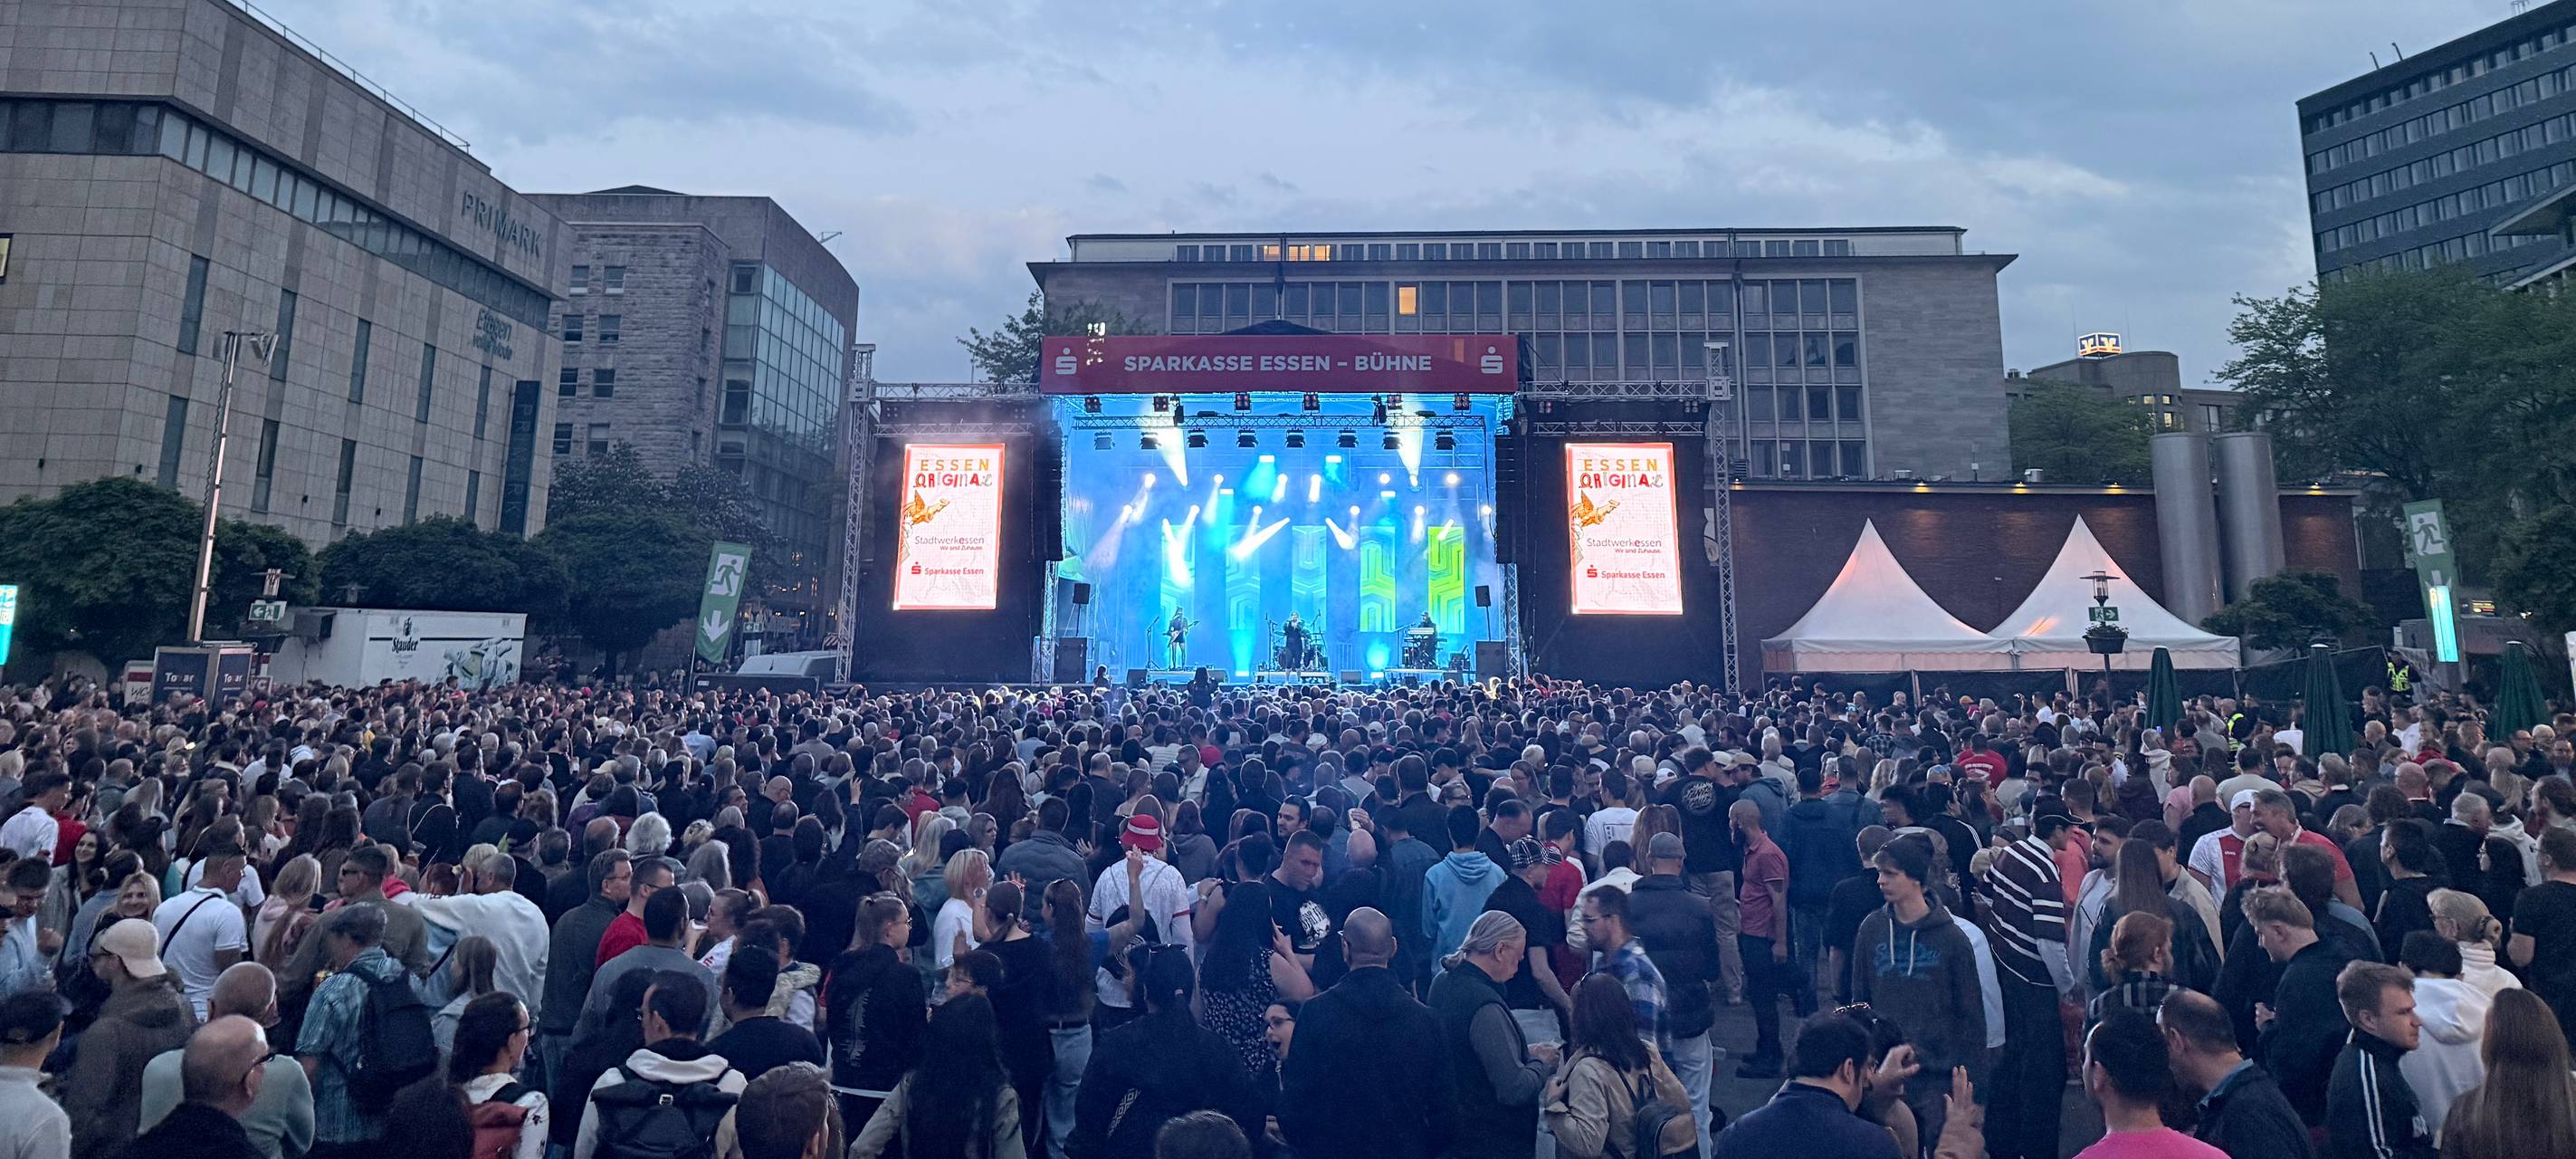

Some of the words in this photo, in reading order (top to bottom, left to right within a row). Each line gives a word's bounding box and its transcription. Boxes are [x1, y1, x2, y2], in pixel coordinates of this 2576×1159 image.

[462, 189, 542, 259] PRIMARK
[1123, 355, 1253, 372] SPARKASSE
[1259, 355, 1331, 371] ESSEN
[1355, 350, 1432, 371] BÜHNE
[920, 458, 989, 472] ESSEN
[1583, 458, 1658, 472] ESSEN
[1586, 537, 1663, 548] Stadtwerkessen
[924, 567, 961, 576] Sparkasse
[1600, 570, 1641, 580] Sparkasse
[1642, 570, 1665, 579] Essen
[391, 637, 419, 653] Stauder
